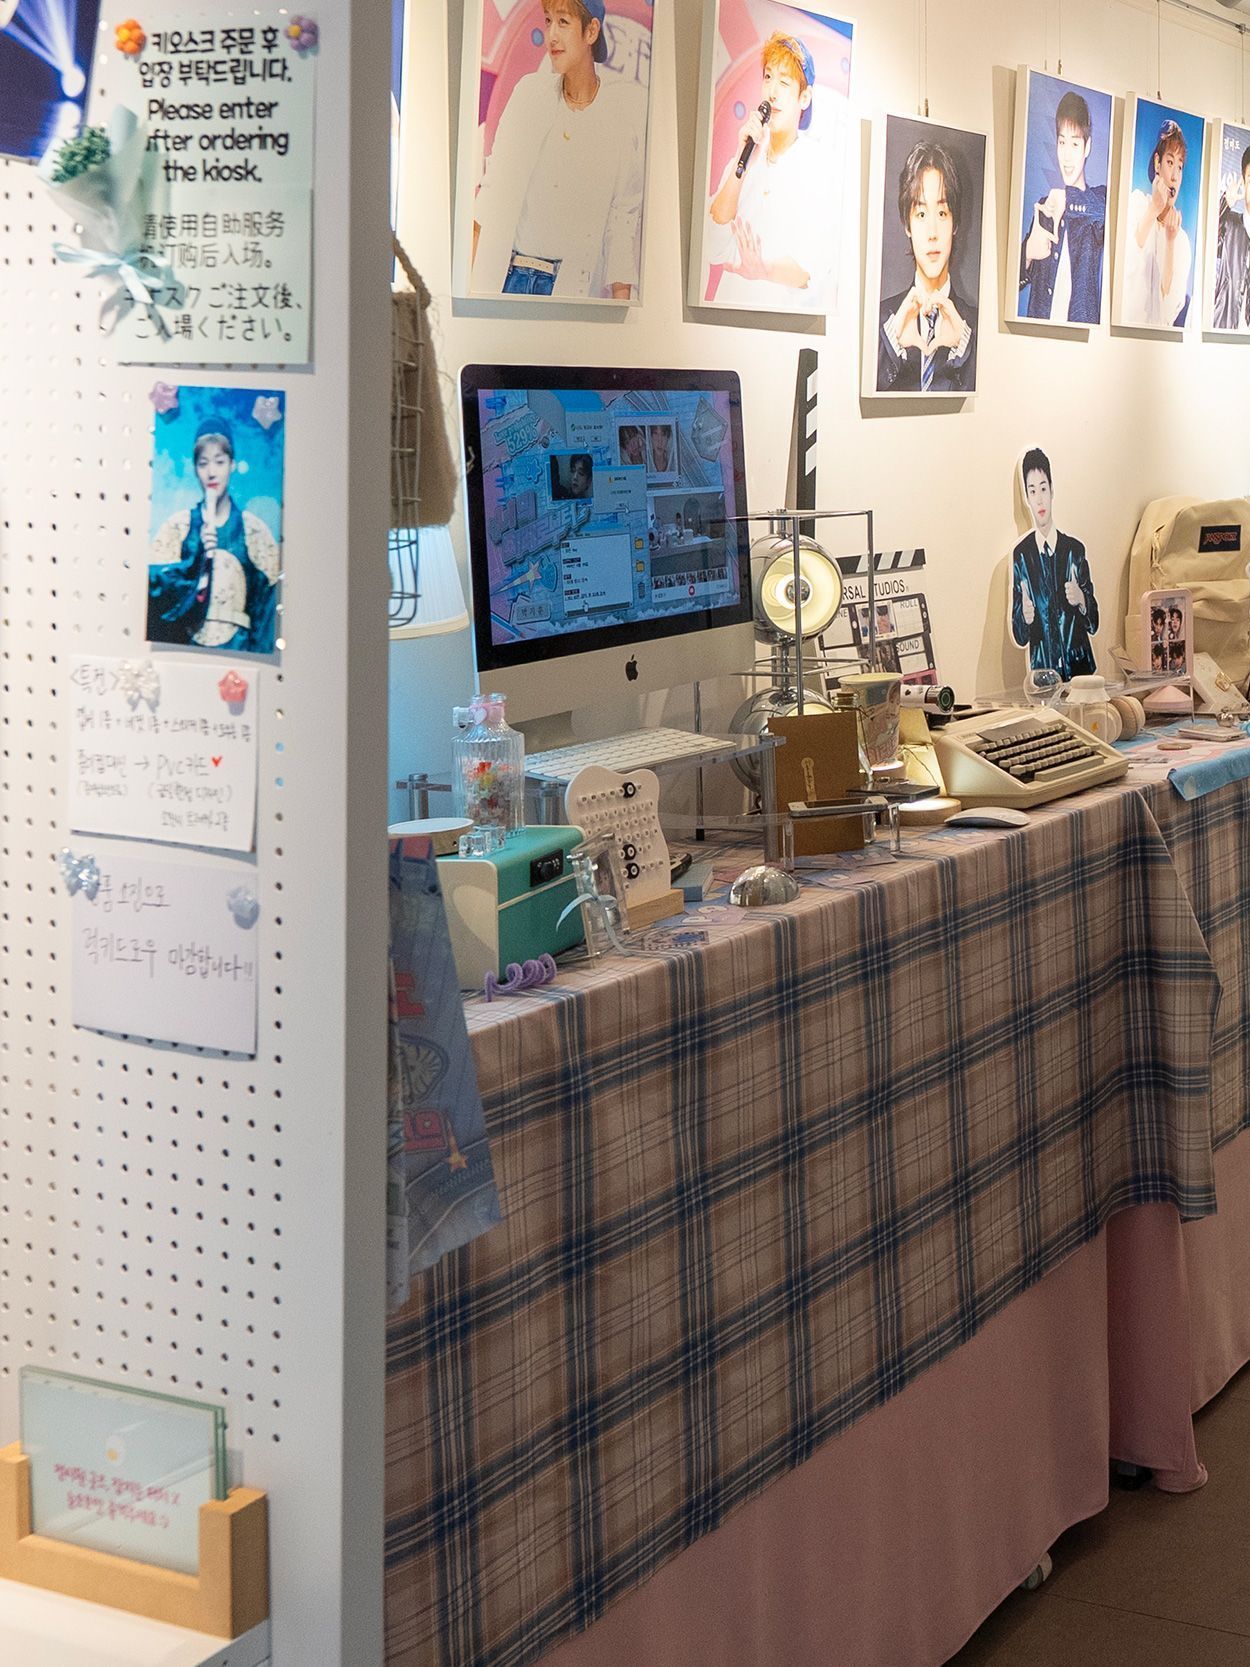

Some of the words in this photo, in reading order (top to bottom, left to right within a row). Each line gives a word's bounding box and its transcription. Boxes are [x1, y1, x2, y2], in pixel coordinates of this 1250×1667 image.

[152, 31, 215, 53] 키오스크
[221, 28, 256, 52] 주문
[261, 26, 279, 53] 후
[139, 61, 173, 88] 입장
[179, 58, 292, 86] 부탁드립니다.
[148, 99, 213, 122] Please
[219, 101, 278, 121] enter
[199, 131, 289, 155] ordering
[163, 161, 197, 182] the
[202, 158, 262, 183] kiosk.
[873, 579, 906, 597] TUDIOS
